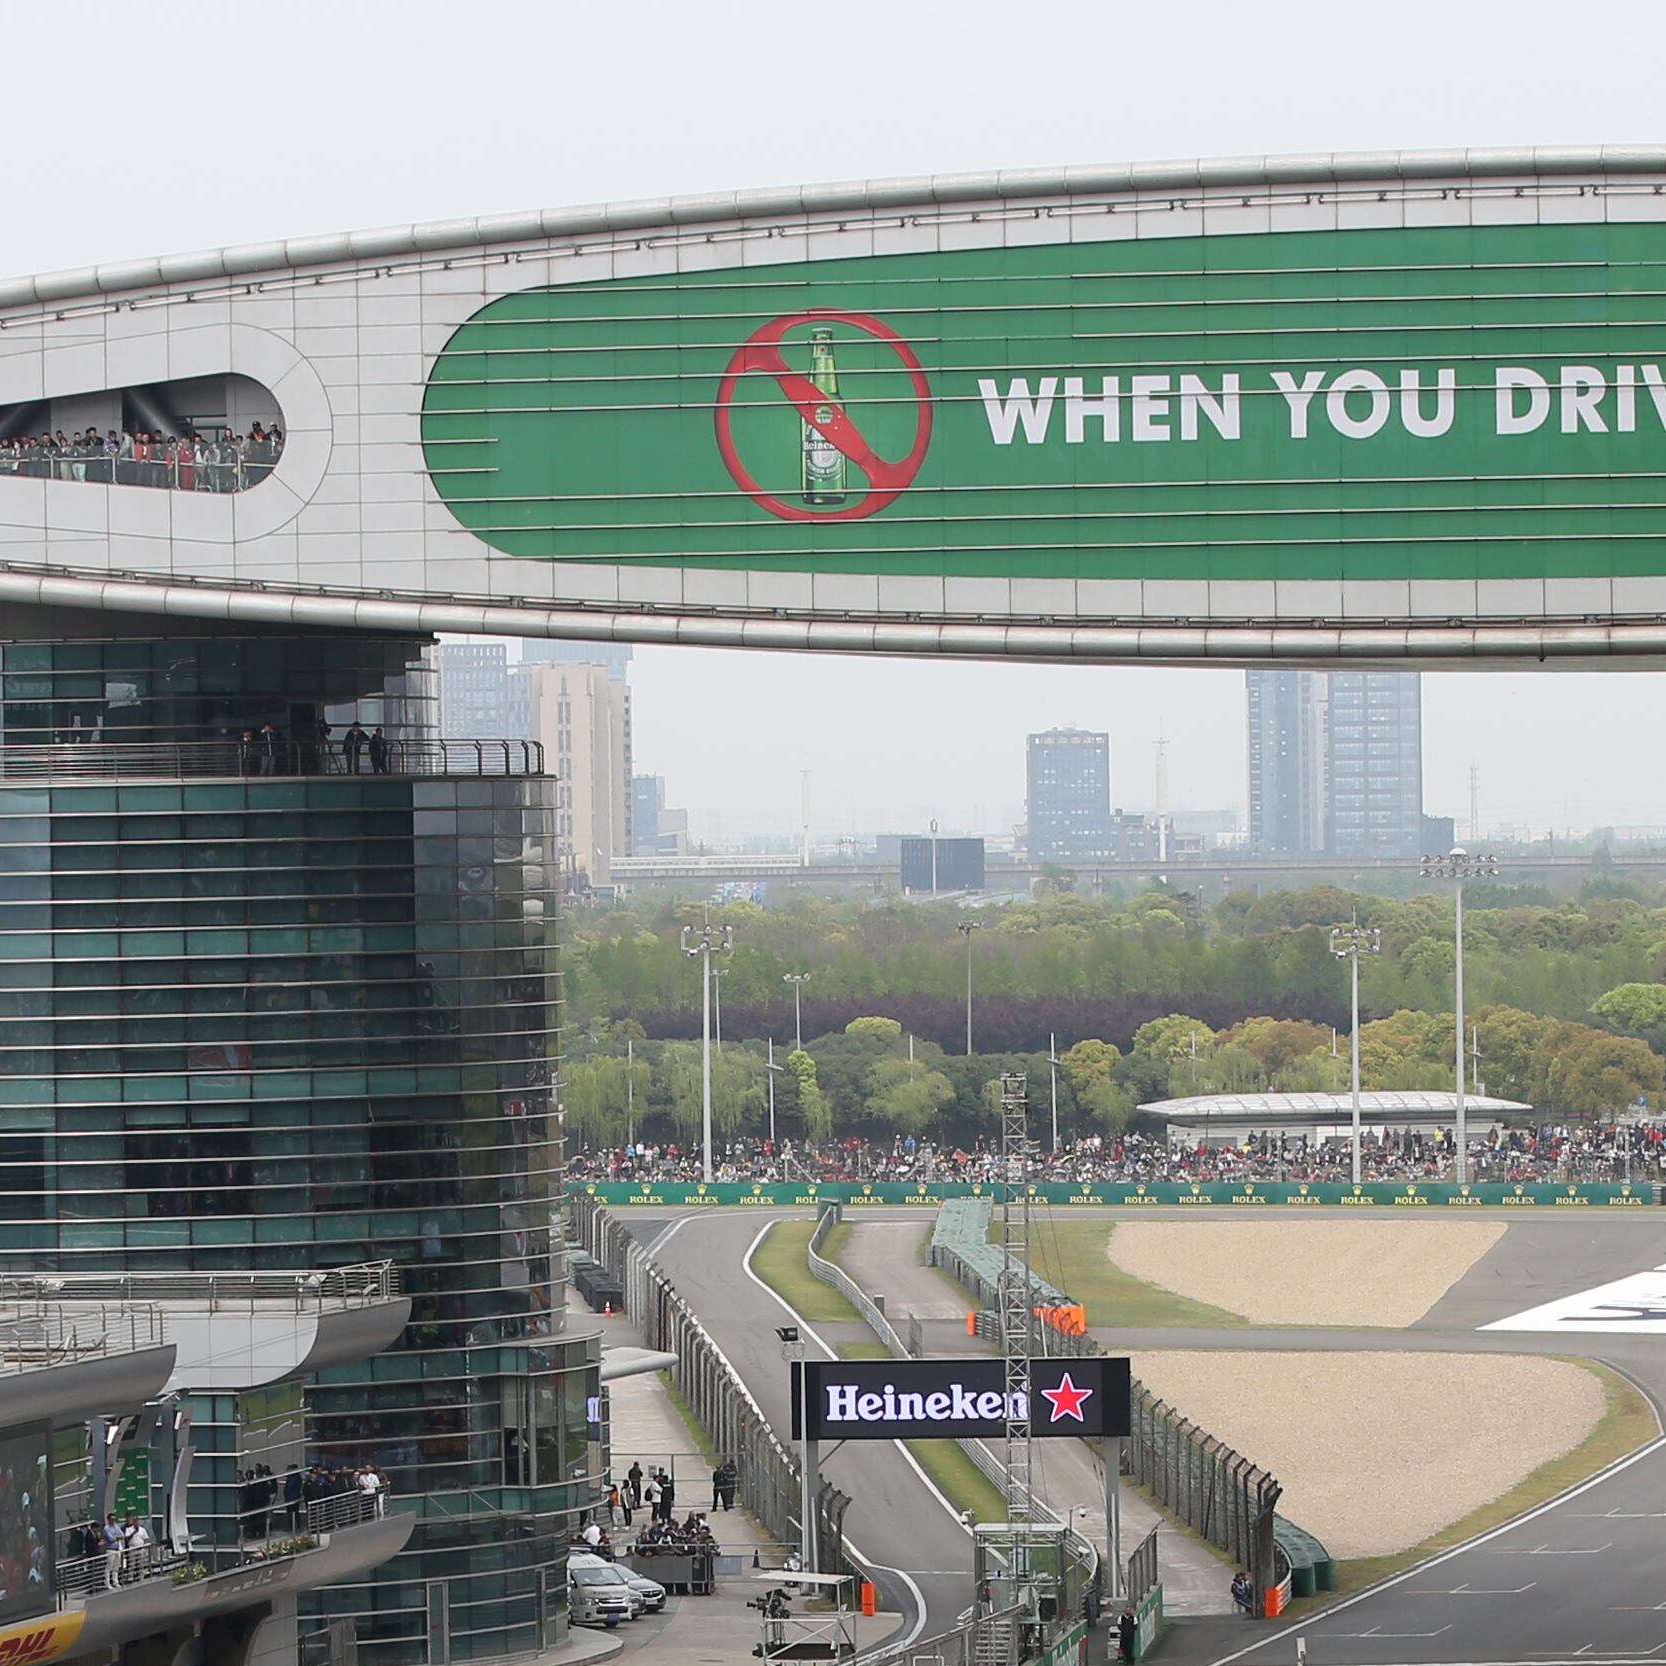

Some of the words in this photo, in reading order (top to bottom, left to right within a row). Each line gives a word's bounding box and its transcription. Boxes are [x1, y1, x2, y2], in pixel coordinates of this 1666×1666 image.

[977, 373, 1241, 444] WHEN
[1269, 368, 1456, 439] YOU
[630, 1196, 664, 1204] ROLEX
[685, 1196, 718, 1204] ROLEX
[740, 1196, 774, 1204] ROLEX
[850, 1196, 883, 1204] ROLEX
[1069, 1196, 1103, 1204] ROLEX
[1124, 1196, 1158, 1204] ROLEX
[1179, 1196, 1213, 1204] ROLEX
[1232, 1196, 1266, 1204] ROLEX
[1287, 1196, 1321, 1204] ROLEX
[1340, 1196, 1374, 1204] ROLEX
[1395, 1196, 1428, 1204] ROLEX
[825, 1383, 1029, 1421] Heineken
